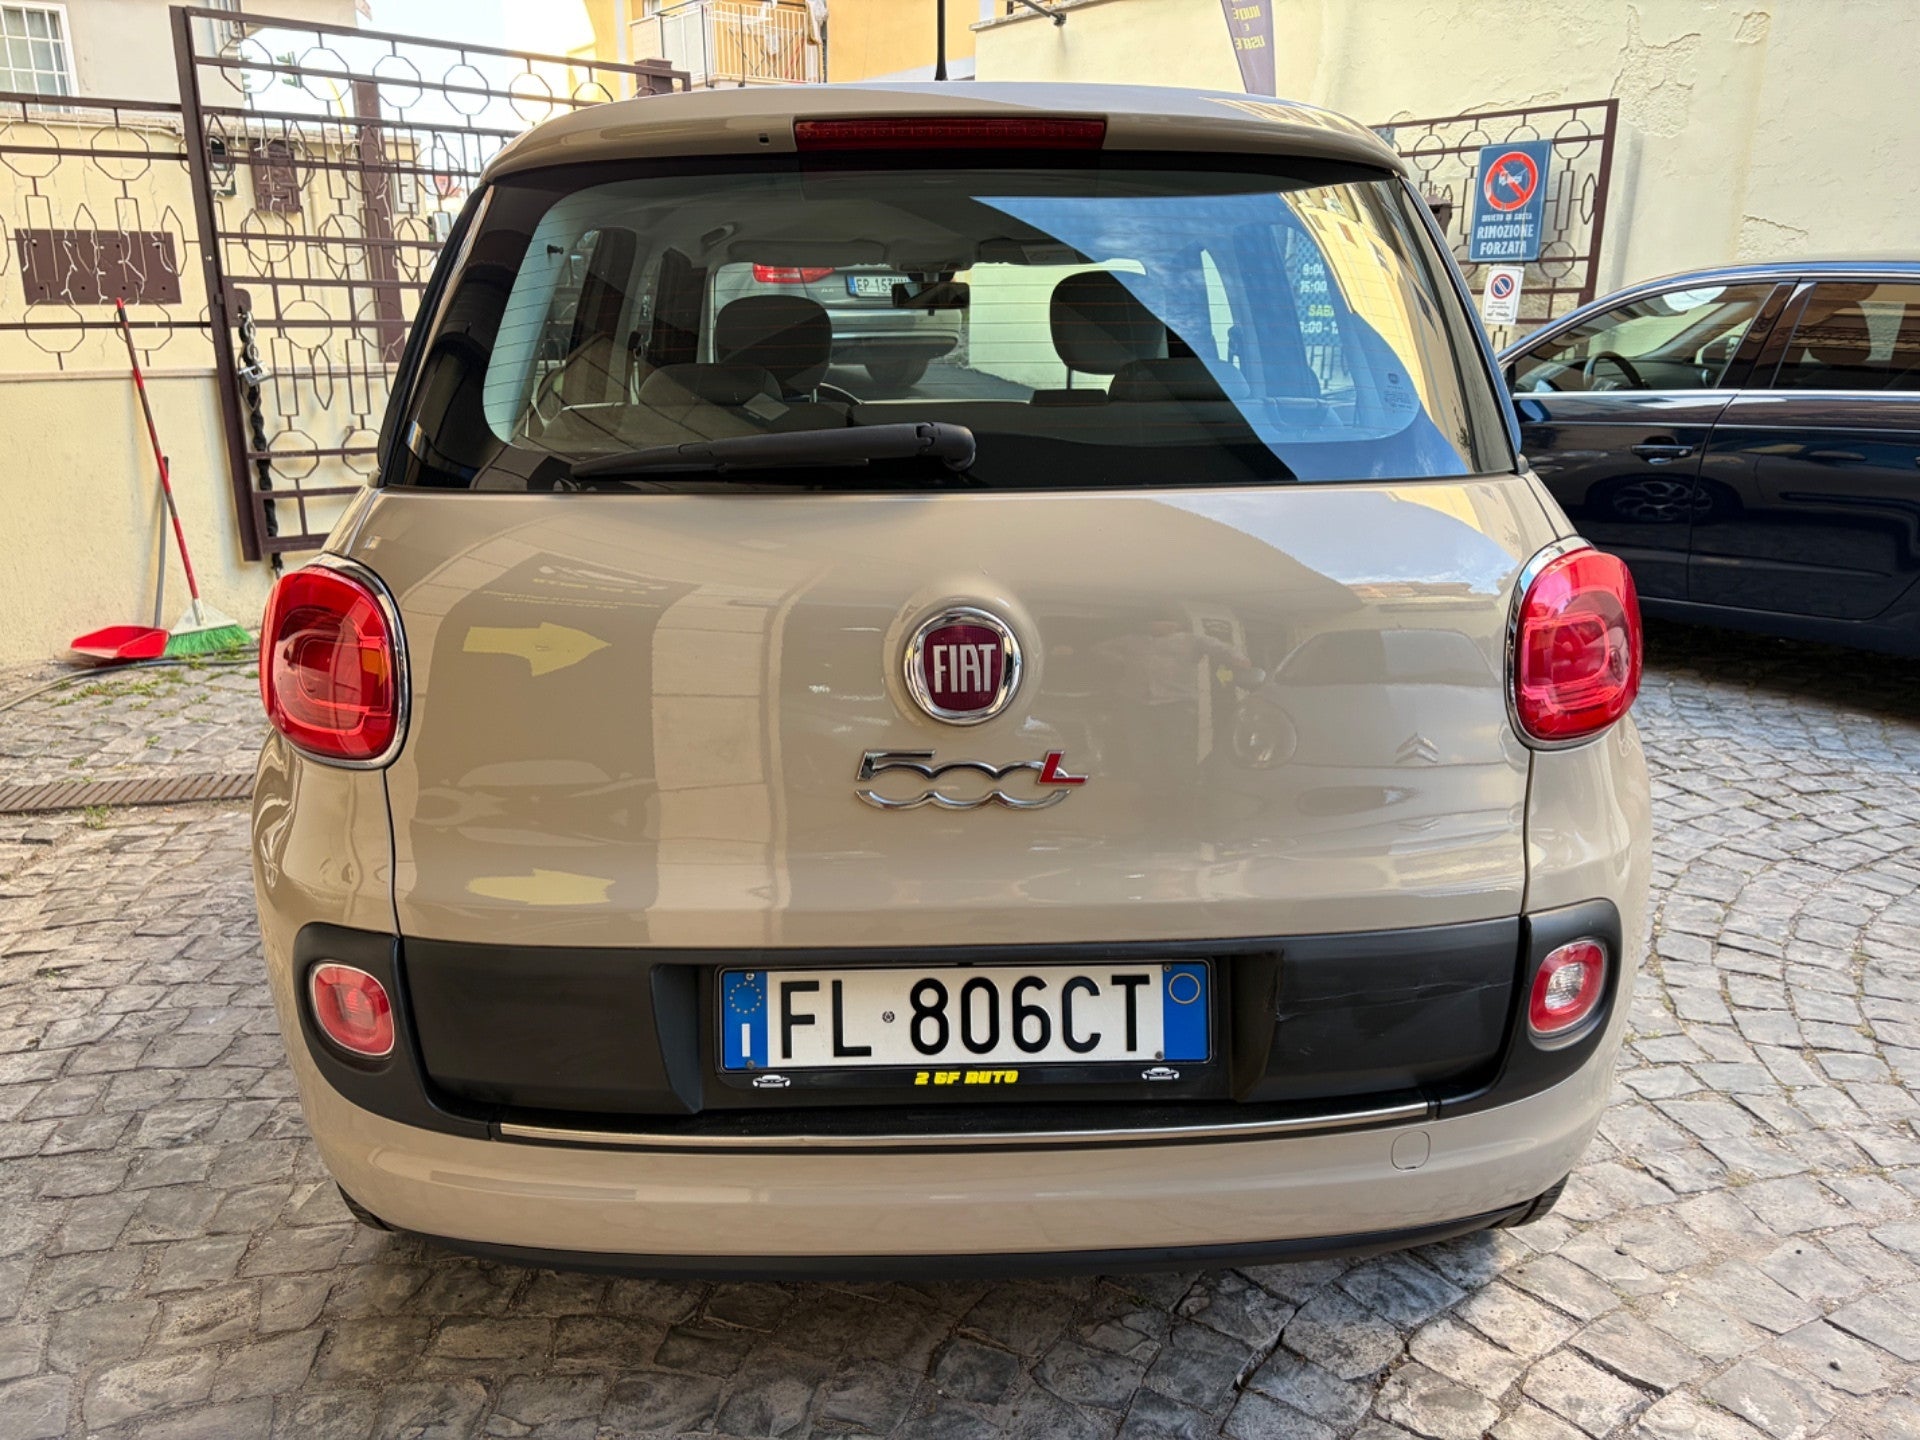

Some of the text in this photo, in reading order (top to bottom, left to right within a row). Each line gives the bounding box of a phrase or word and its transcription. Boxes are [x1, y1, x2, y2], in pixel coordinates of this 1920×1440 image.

[1477, 224, 1534, 239] RIMOZIONE
[1480, 241, 1527, 255] FORZATA
[856, 277, 907, 292] EP 153
[932, 643, 997, 694] FIAT
[855, 749, 1089, 811] 500L
[780, 974, 1151, 1059] FL 806CT
[741, 1023, 751, 1058] I
[914, 1070, 1019, 1086] 2 GF AUTO
